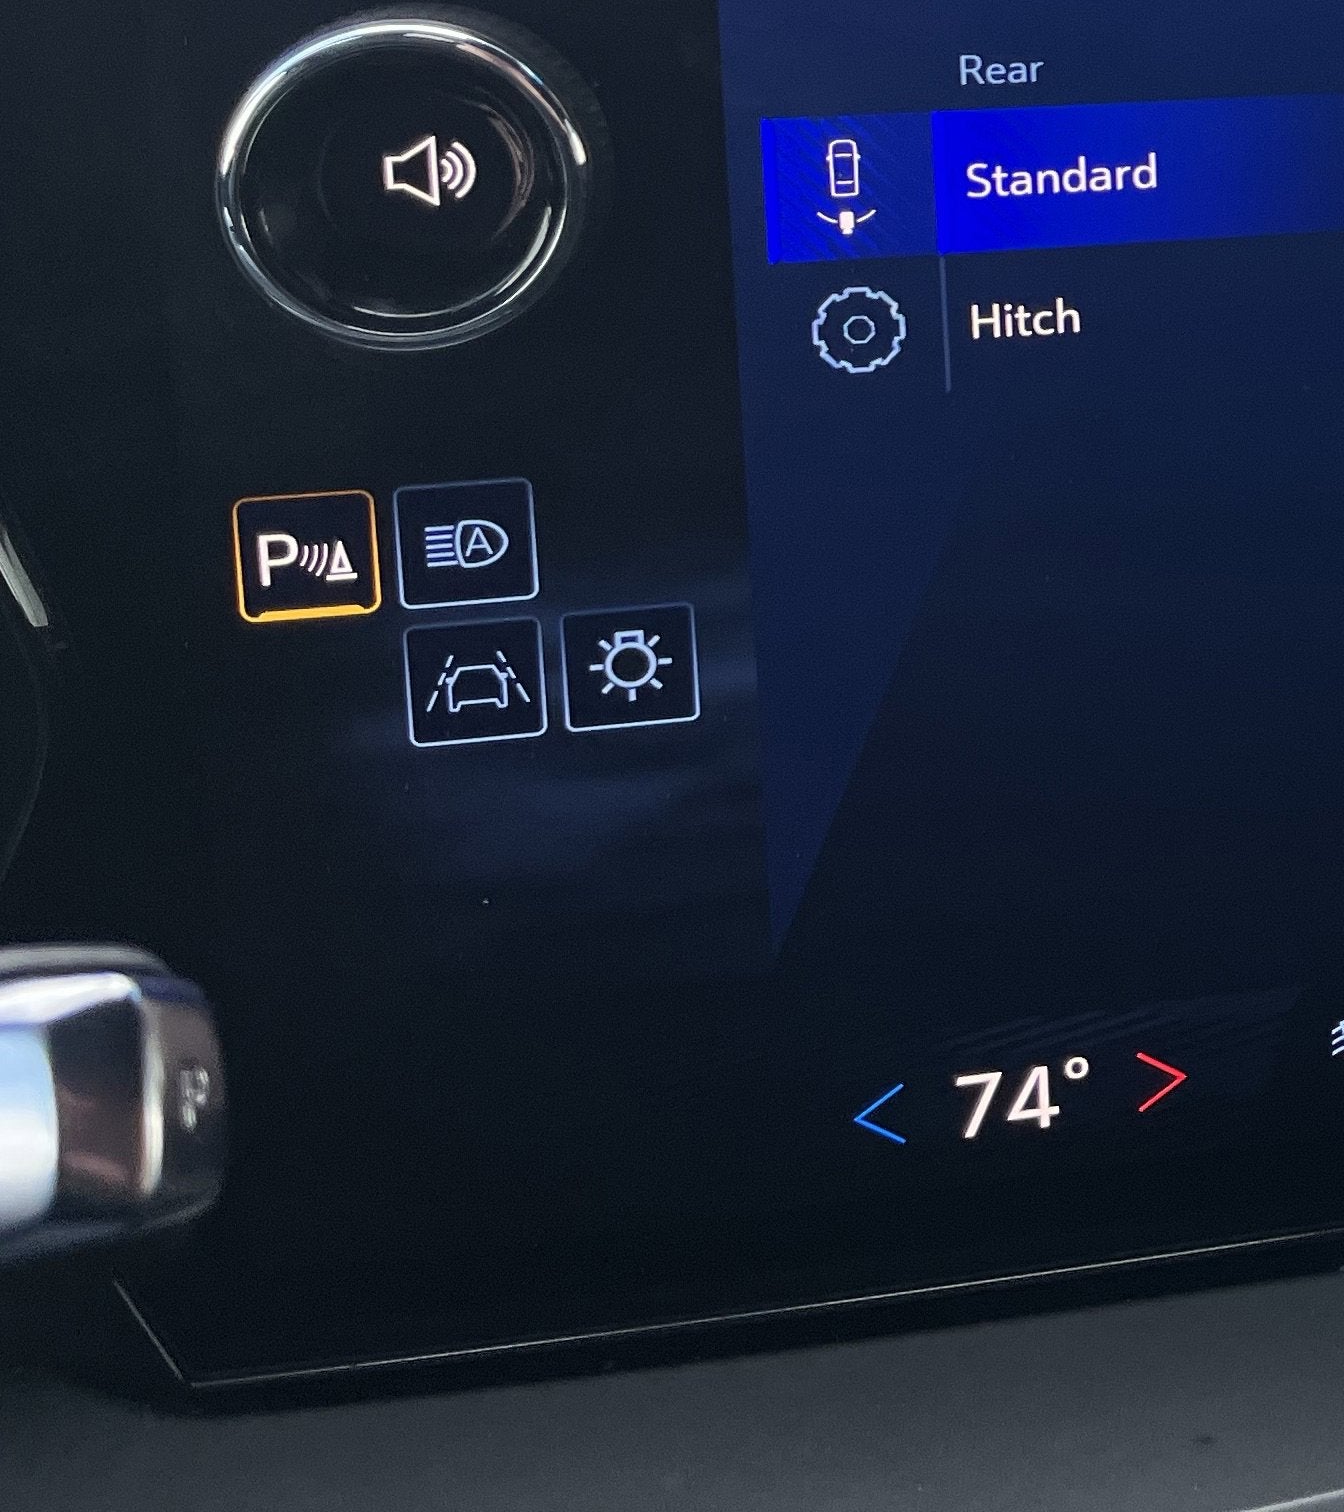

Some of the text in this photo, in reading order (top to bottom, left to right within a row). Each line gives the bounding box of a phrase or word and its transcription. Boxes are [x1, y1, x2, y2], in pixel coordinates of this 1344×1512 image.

[960, 55, 1044, 85] Rear
[967, 152, 1157, 197] Standard
[971, 298, 1080, 339] Hitch
[955, 1057, 1088, 1138] 74°
